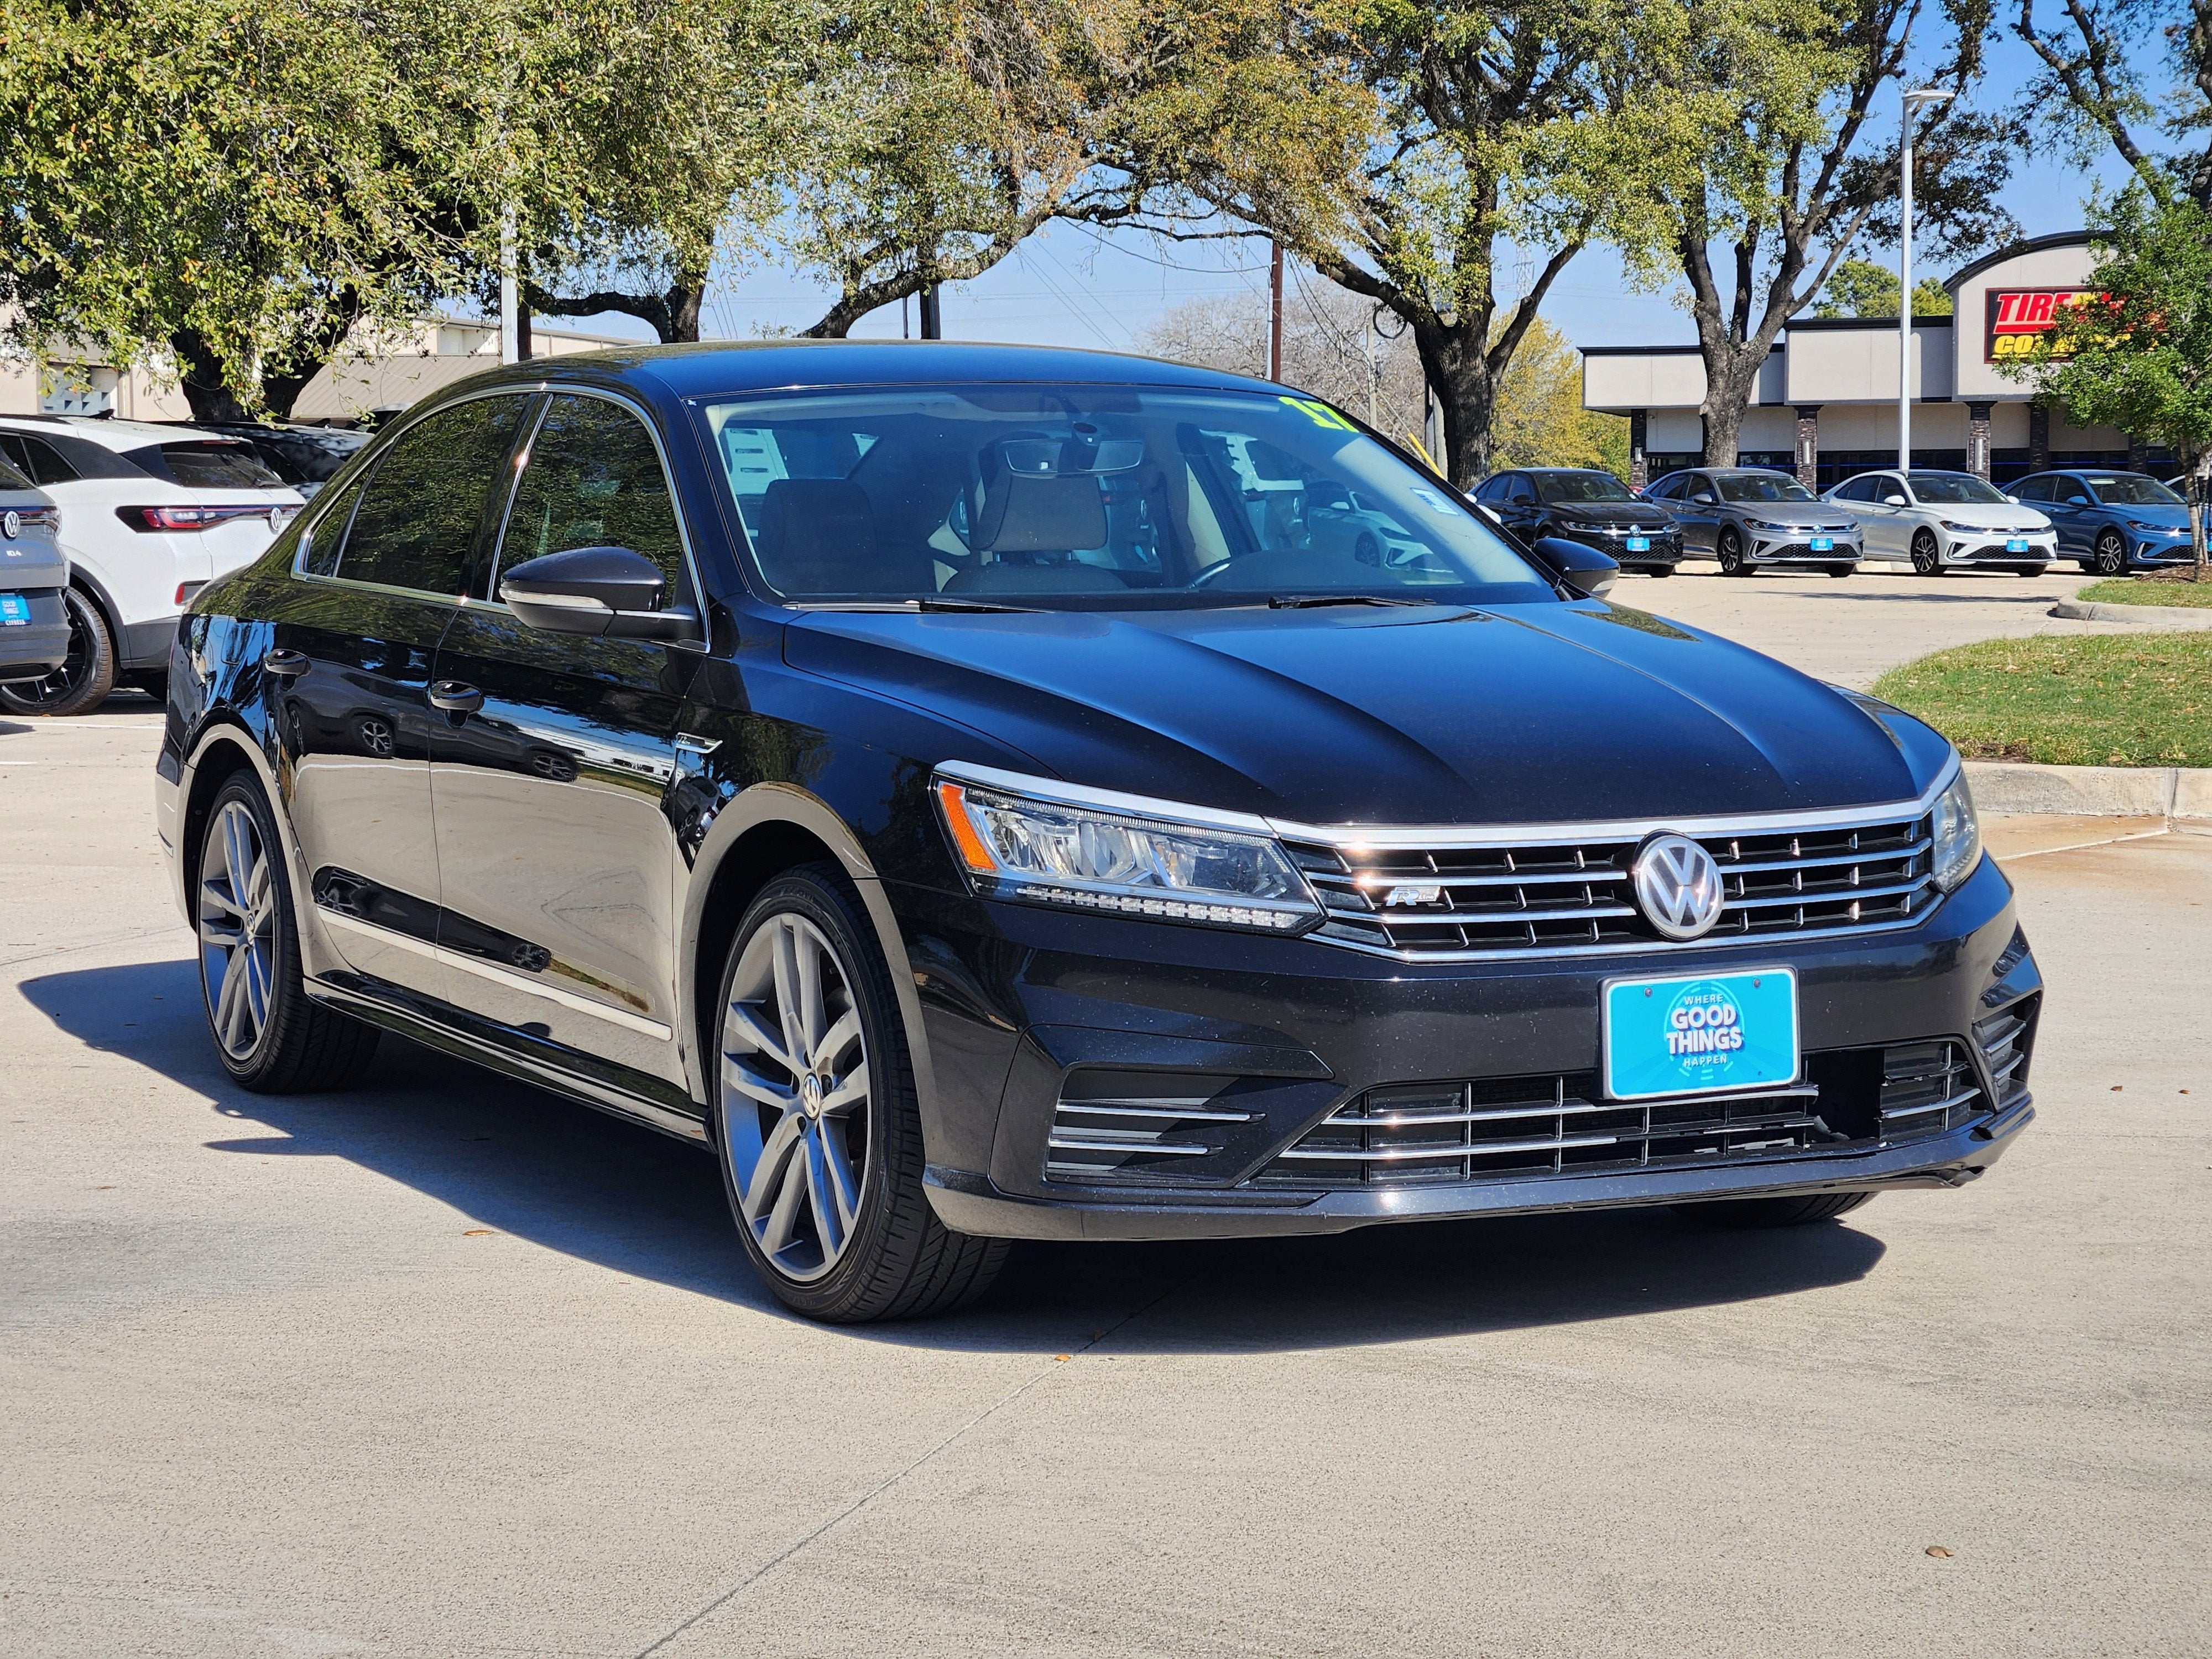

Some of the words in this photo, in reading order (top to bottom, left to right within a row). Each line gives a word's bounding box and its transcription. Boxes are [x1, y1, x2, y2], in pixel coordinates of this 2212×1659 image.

[1279, 396, 1359, 433] 17
[1637, 834, 1723, 936] VW
[1684, 994, 1724, 1005] WHERE
[1671, 1003, 1737, 1030] GOOD
[1666, 1026, 1743, 1055] THINGS
[1683, 1055, 1728, 1067] HAPPEN
